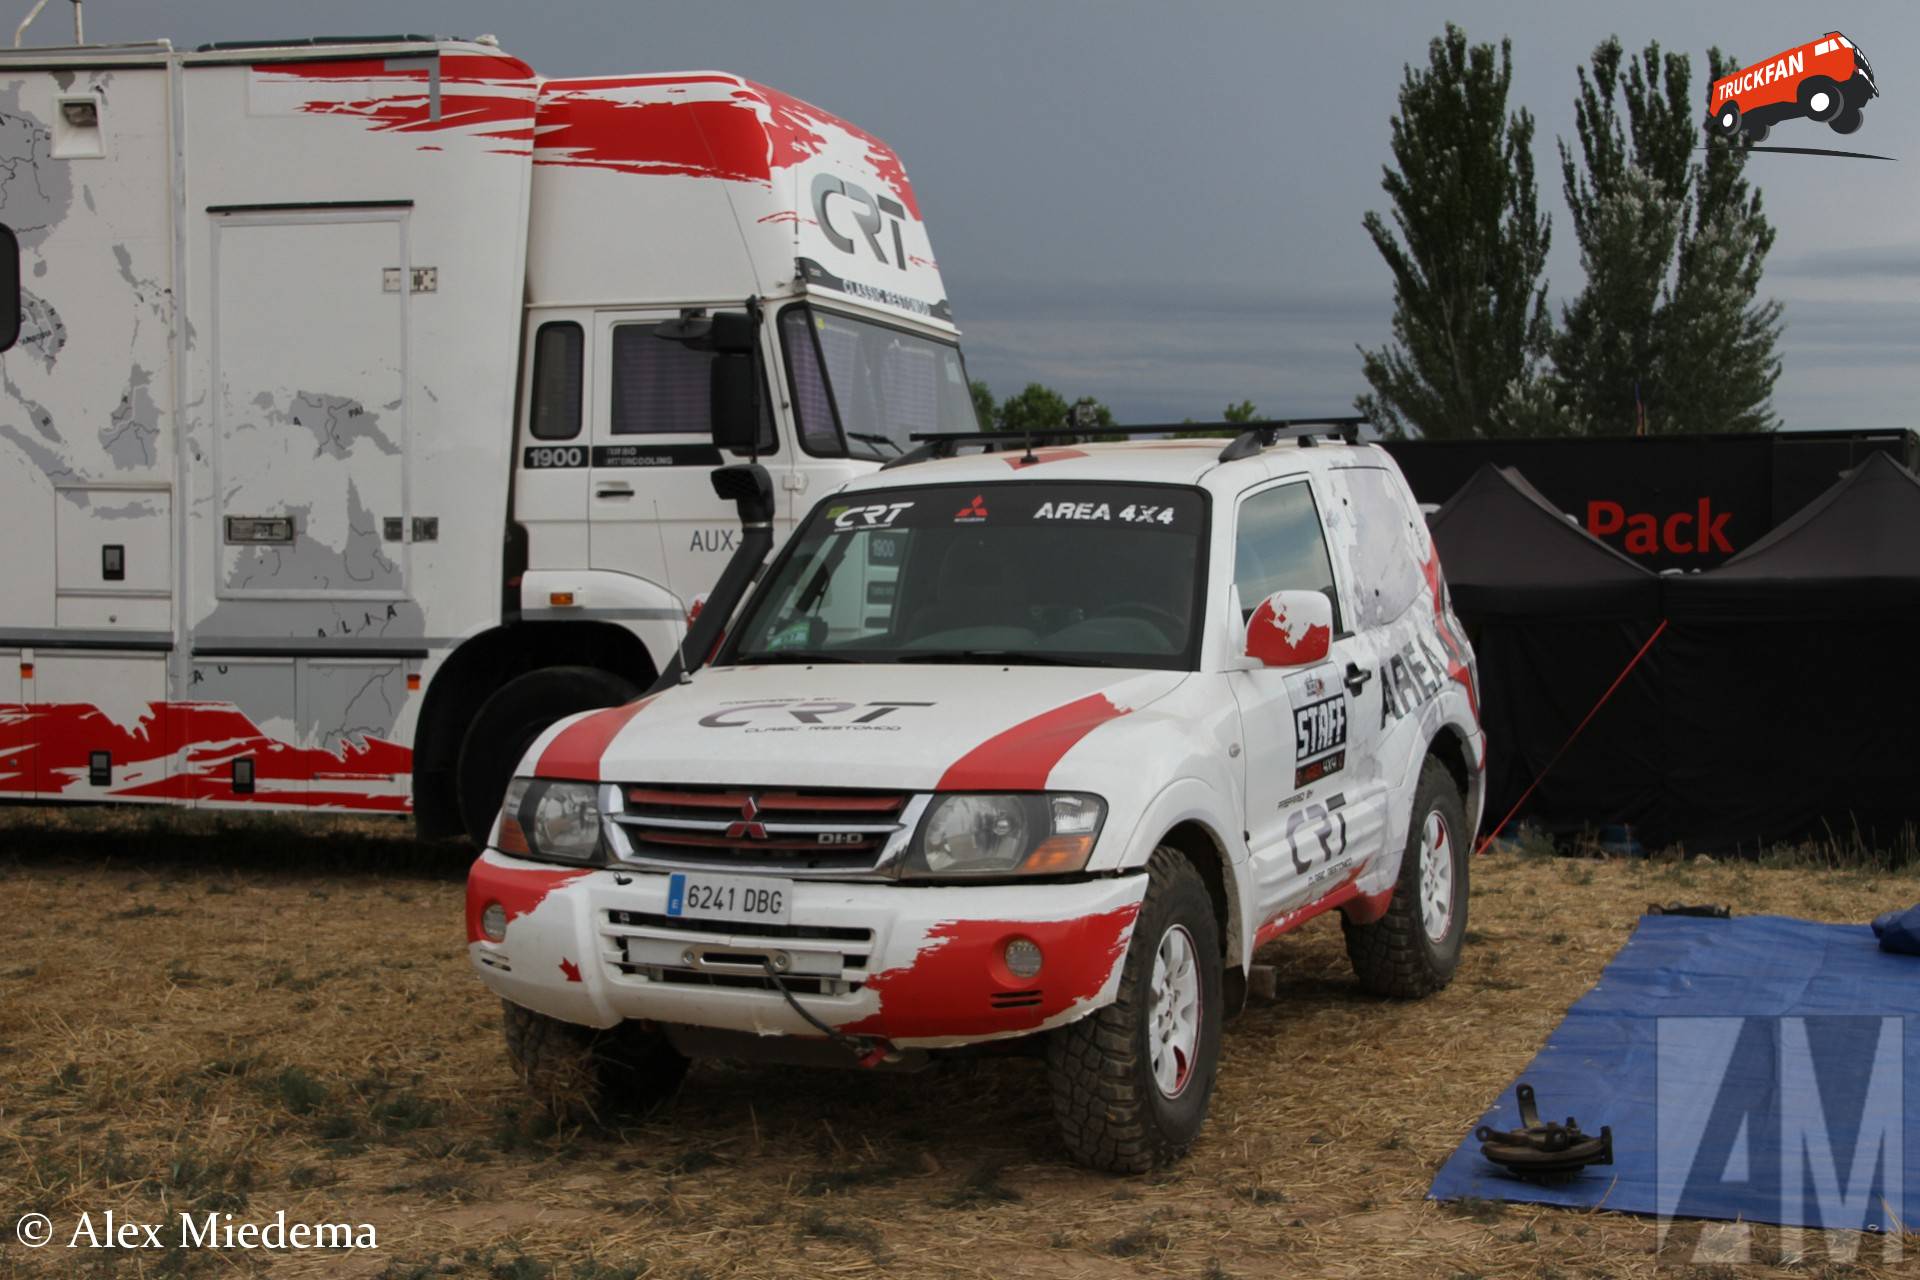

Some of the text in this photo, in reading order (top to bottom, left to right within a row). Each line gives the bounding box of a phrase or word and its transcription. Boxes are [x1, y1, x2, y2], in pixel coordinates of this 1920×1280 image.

[811, 173, 907, 271] CRT
[530, 449, 582, 466] 1900
[834, 502, 915, 527] CRT
[1033, 502, 1111, 521] AREA
[1587, 496, 1735, 555] Pack
[698, 702, 937, 728] CRT
[1297, 696, 1345, 759] STAFF
[1286, 792, 1346, 875] CRT
[687, 884, 783, 914] 6241 DBG
